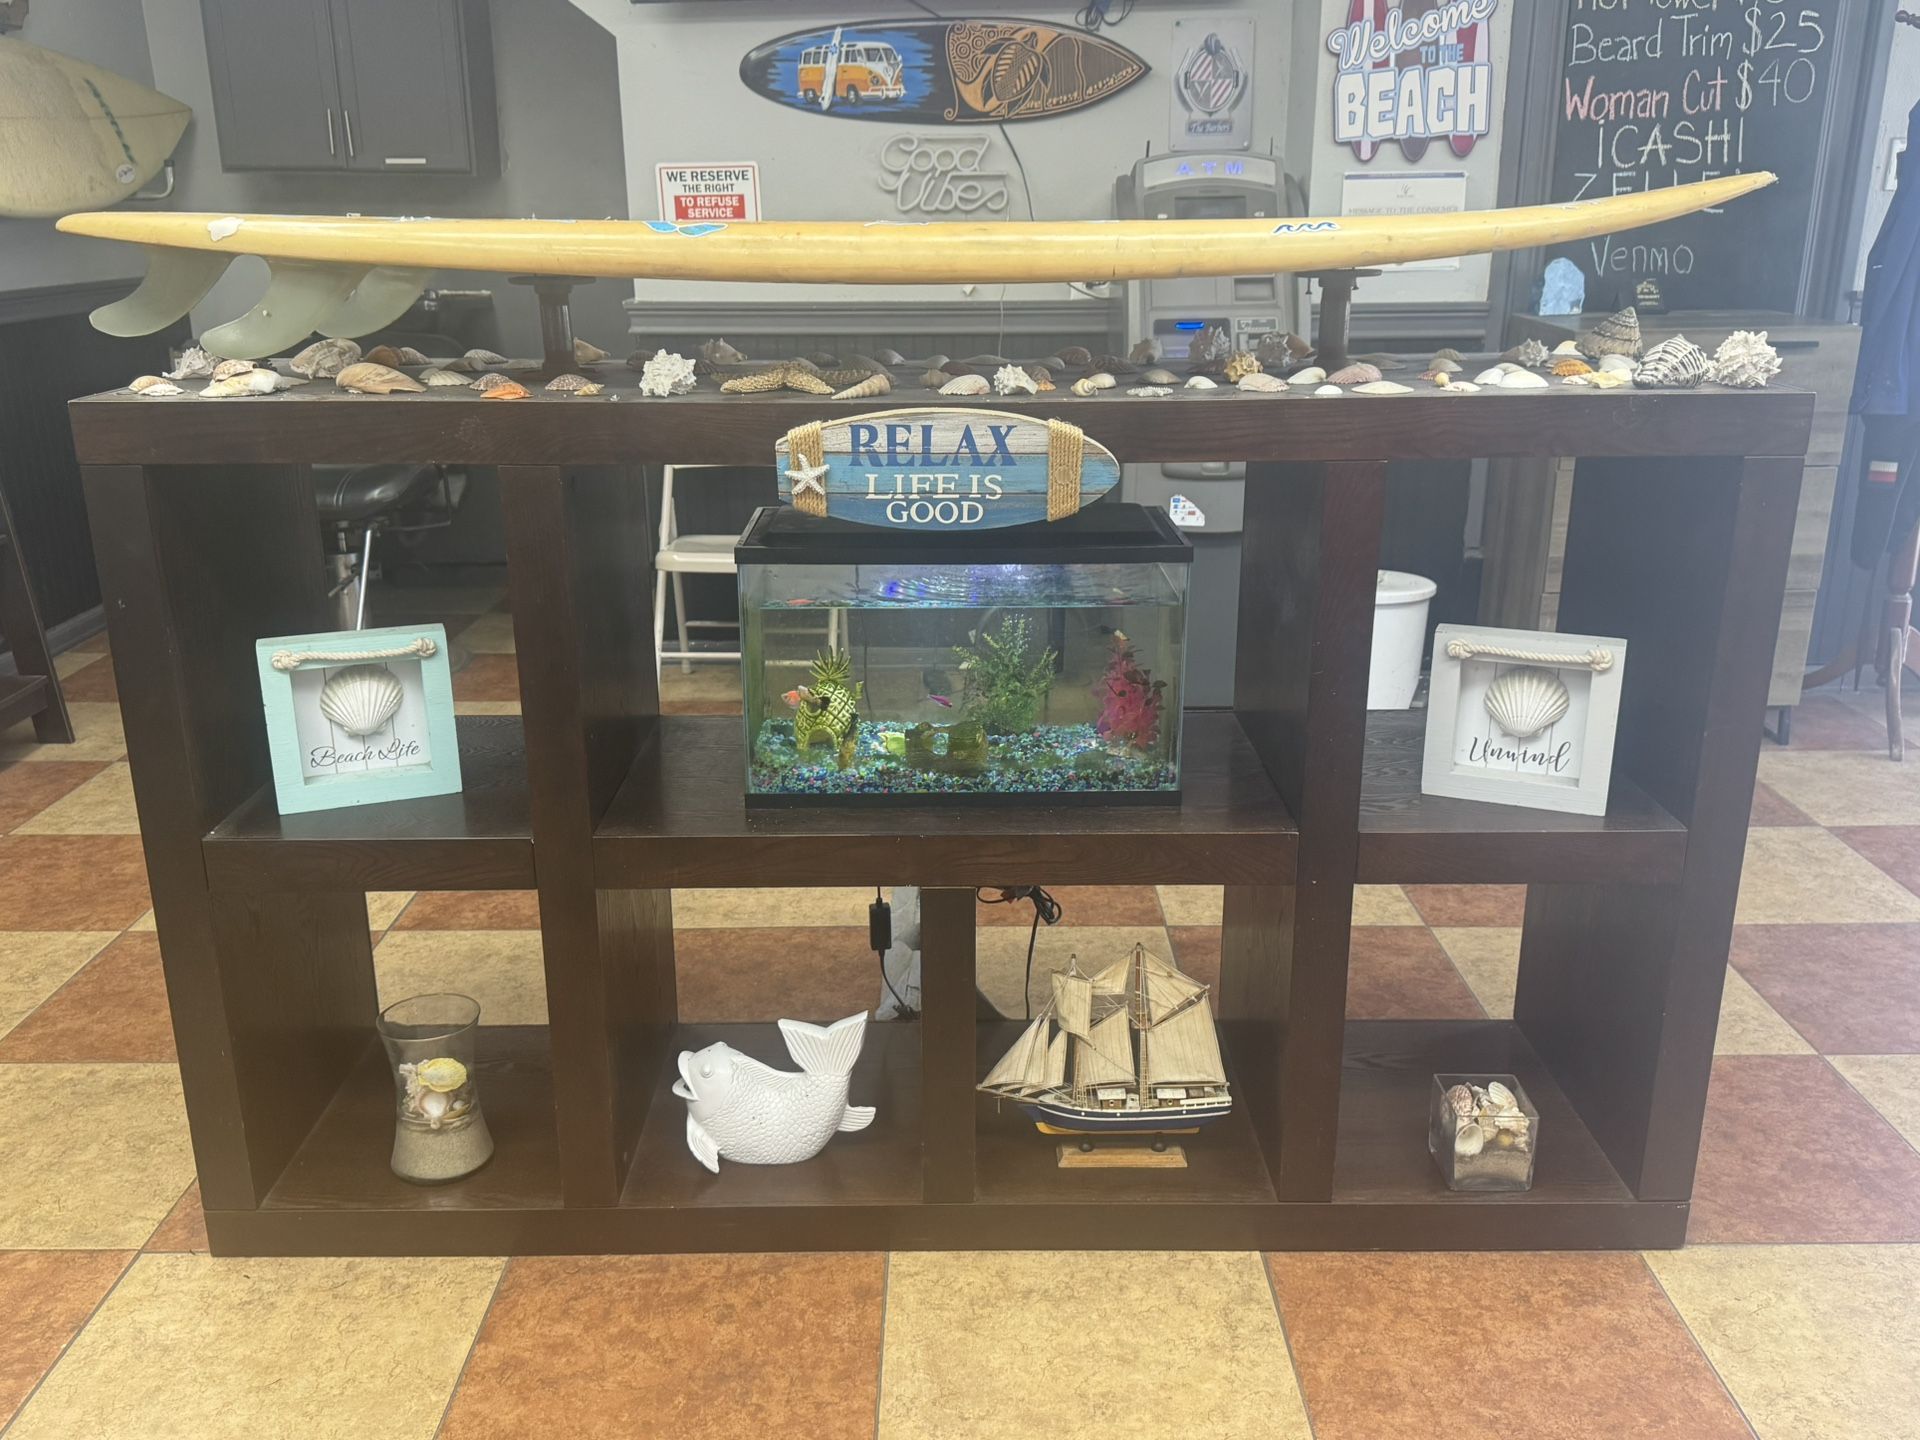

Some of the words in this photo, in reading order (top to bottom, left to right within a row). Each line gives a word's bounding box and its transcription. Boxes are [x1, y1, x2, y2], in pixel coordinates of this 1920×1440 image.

[1329, 0, 1496, 69] Welcome
[1568, 18, 1662, 66] Beard
[1670, 13, 1733, 59] Trim
[1742, 3, 1825, 57] $25
[1419, 45, 1437, 63] TO
[1440, 43, 1465, 62] THE
[1337, 65, 1489, 139] BEACH
[1565, 75, 1669, 121] Woman
[1683, 66, 1728, 115] Cut
[1735, 57, 1816, 110] $40
[879, 133, 991, 178] Good
[1175, 161, 1245, 176] ATM
[666, 170, 687, 182] WE
[691, 169, 749, 181] RESERVE
[682, 183, 702, 193] THE
[704, 183, 735, 193] RIGHT
[896, 169, 1008, 211] Vibes
[680, 197, 694, 207] TO
[697, 196, 740, 207] REFUSE
[688, 207, 734, 218] SERVICE
[848, 424, 1017, 467] RELAX
[866, 474, 959, 500] LIFE
[968, 474, 1003, 500] IS
[886, 501, 984, 524] GOOD
[311, 746, 376, 768] Beach
[378, 738, 421, 761] Life
[1469, 737, 1571, 772] Unwind
